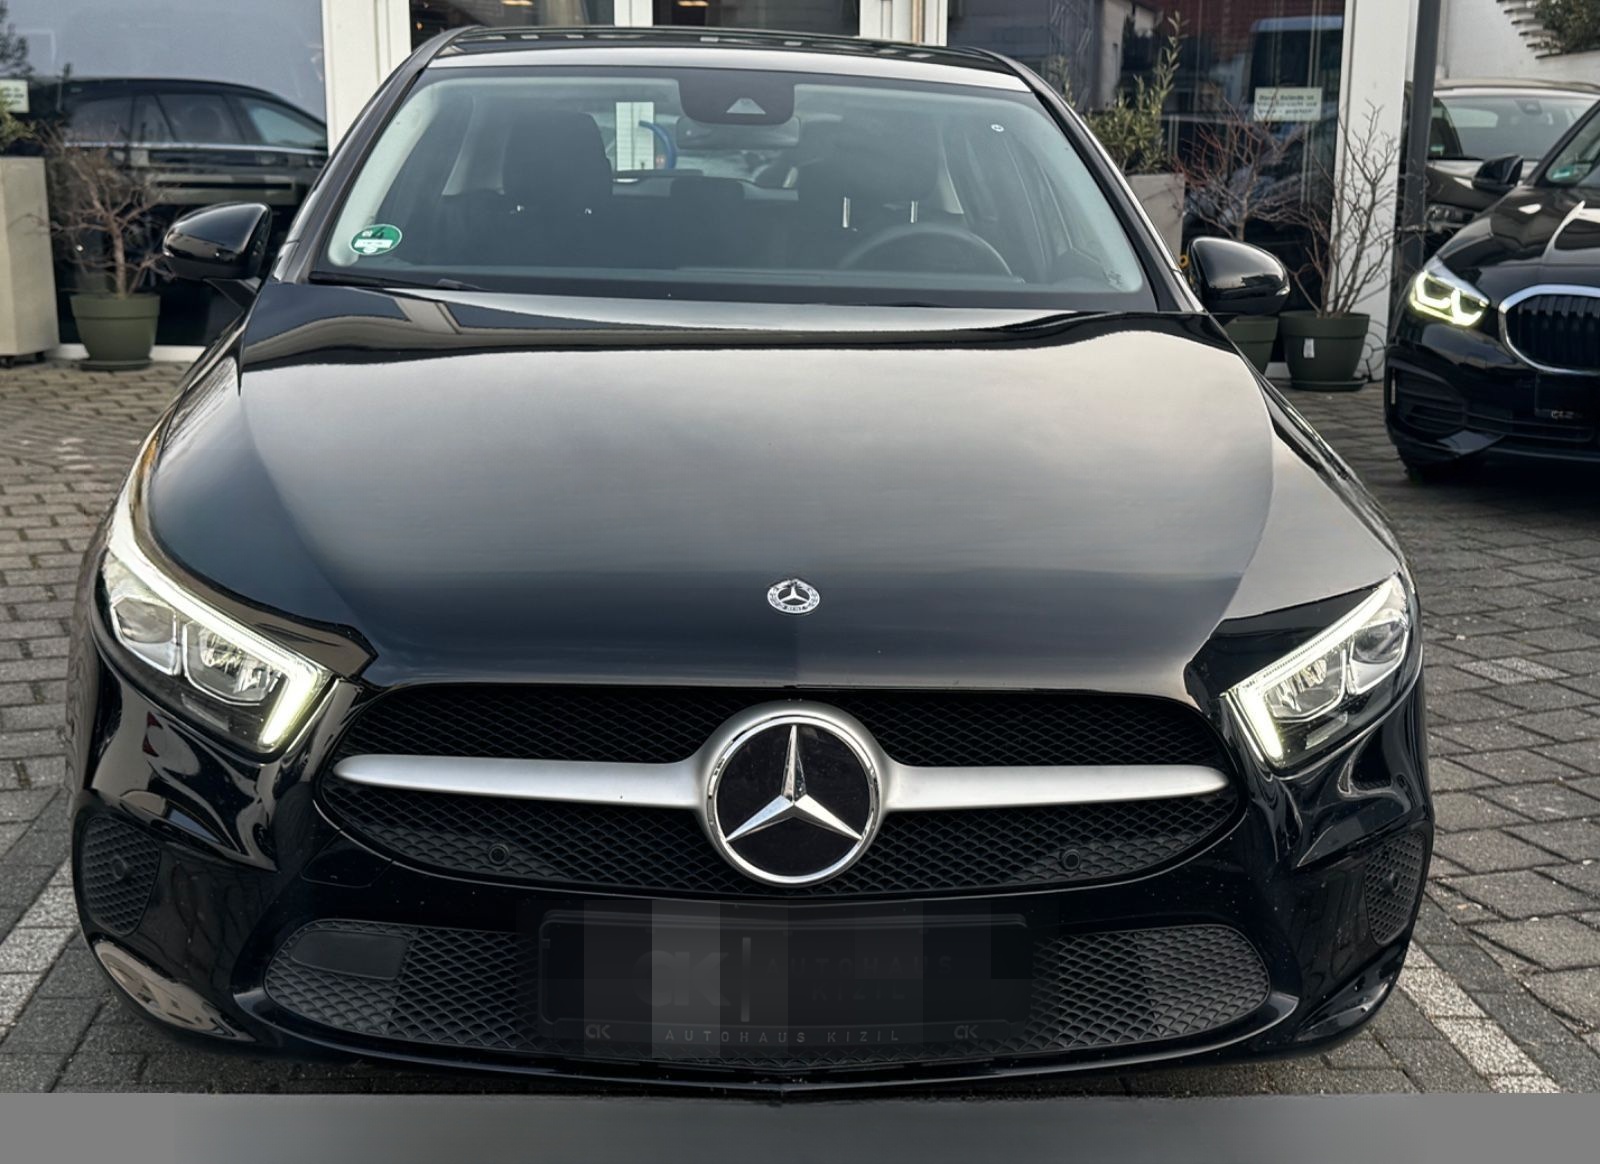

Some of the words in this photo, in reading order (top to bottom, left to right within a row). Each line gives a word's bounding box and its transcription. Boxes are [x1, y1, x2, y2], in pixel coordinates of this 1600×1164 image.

[767, 955, 953, 977] AUTOHAUS
[811, 981, 906, 1002] KIZIL
[664, 1028, 806, 1044] AUTOHAUS
[827, 1029, 899, 1044] KIZIL
